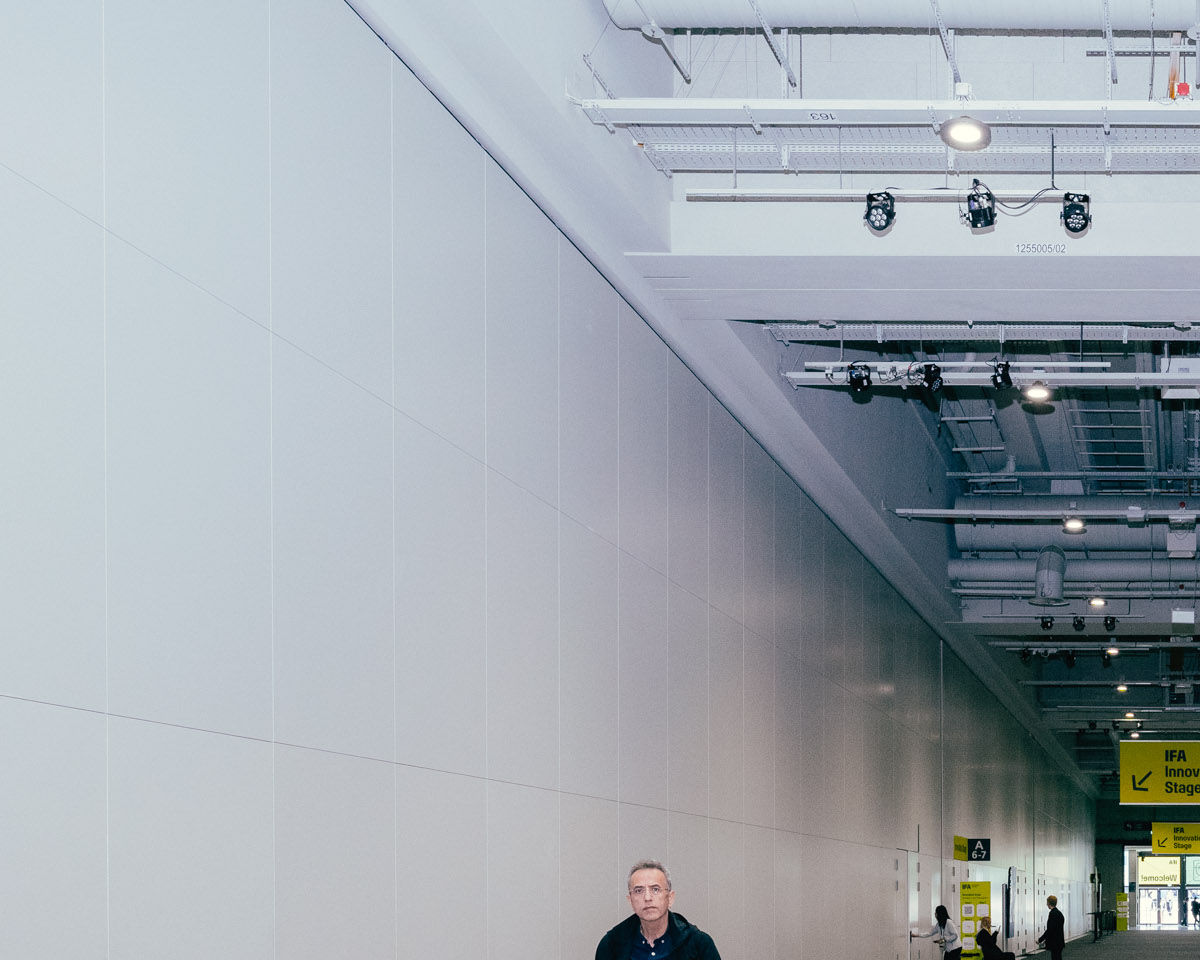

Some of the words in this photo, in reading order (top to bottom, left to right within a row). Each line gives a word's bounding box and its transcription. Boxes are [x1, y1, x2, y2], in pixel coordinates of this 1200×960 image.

[810, 113, 836, 121] 163
[1016, 244, 1066, 253] 1255005/02
[1165, 750, 1187, 762] IFA
[975, 840, 984, 850] A
[971, 850, 987, 860] 6-7
